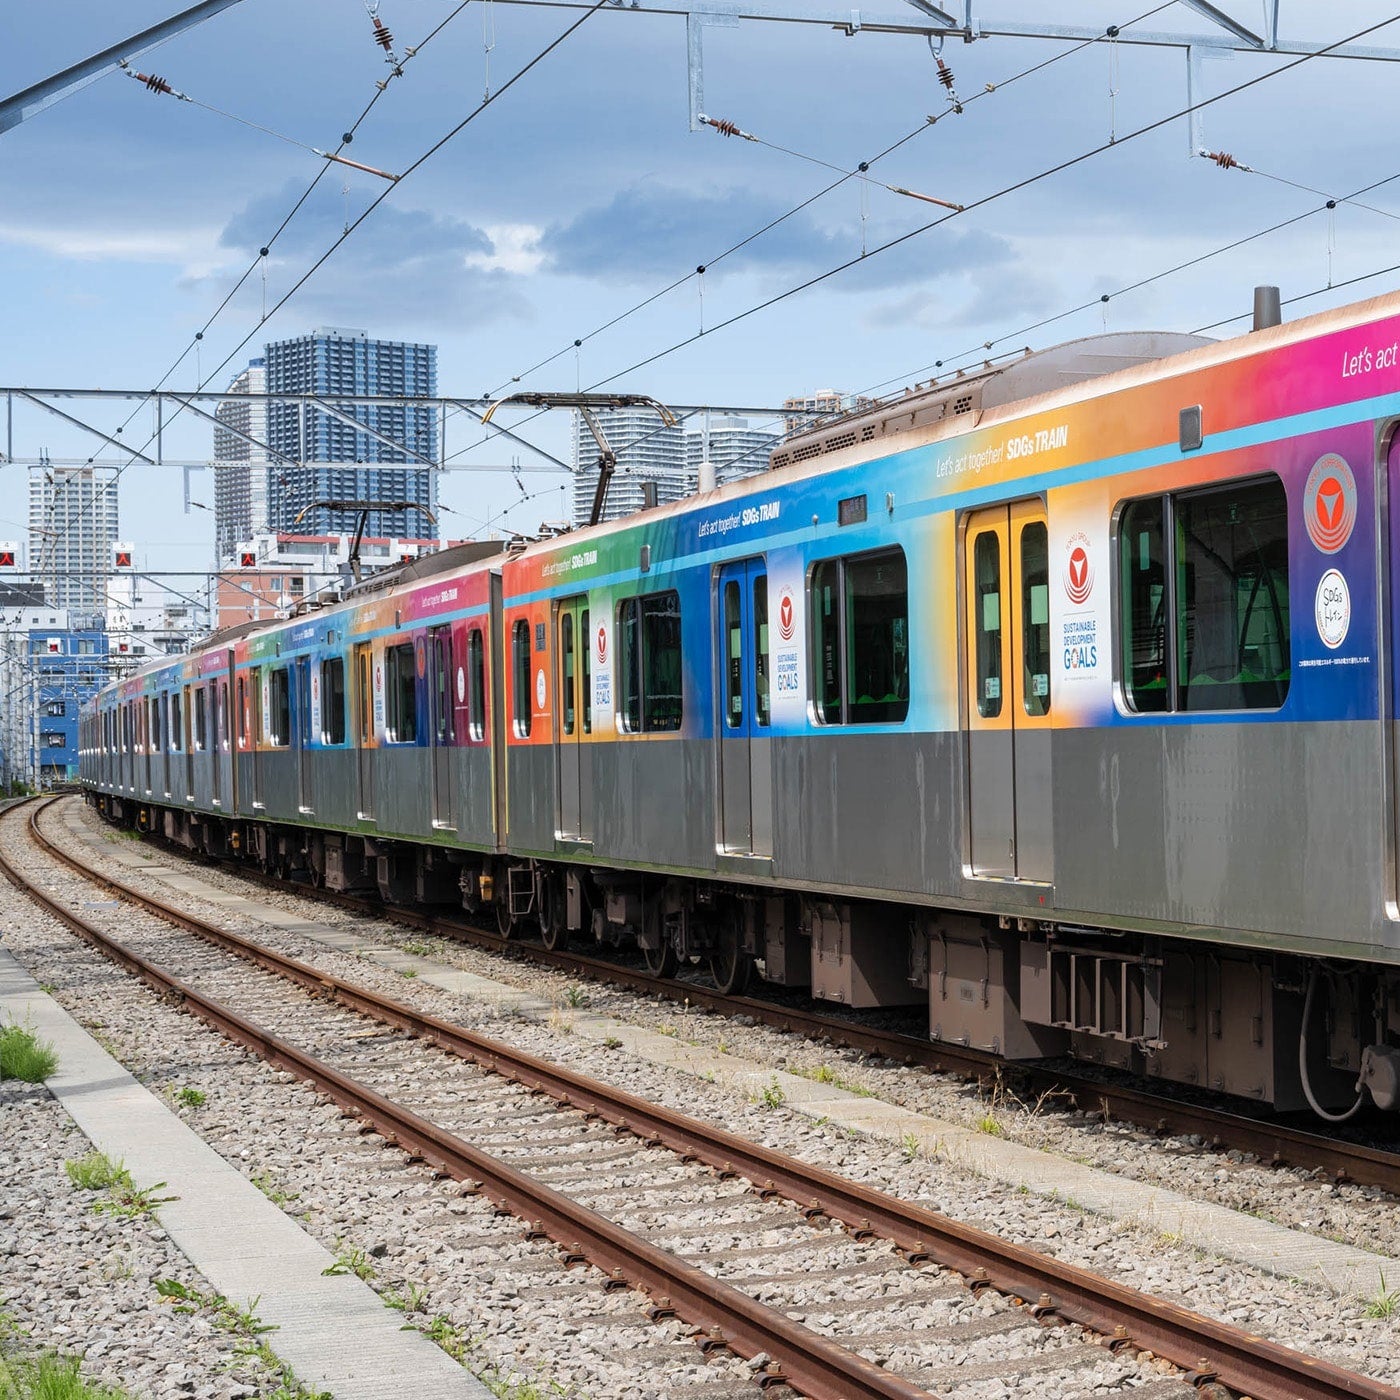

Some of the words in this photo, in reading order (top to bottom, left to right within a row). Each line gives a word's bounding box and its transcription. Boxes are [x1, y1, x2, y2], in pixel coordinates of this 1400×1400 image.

[1342, 346, 1372, 378] Let's
[1375, 345, 1398, 370] act
[954, 455, 967, 474] act
[1006, 435, 1034, 460] SDGs
[1035, 424, 1069, 453] TRAIN
[759, 500, 780, 521] TRAIN
[1063, 645, 1097, 669] GOALS
